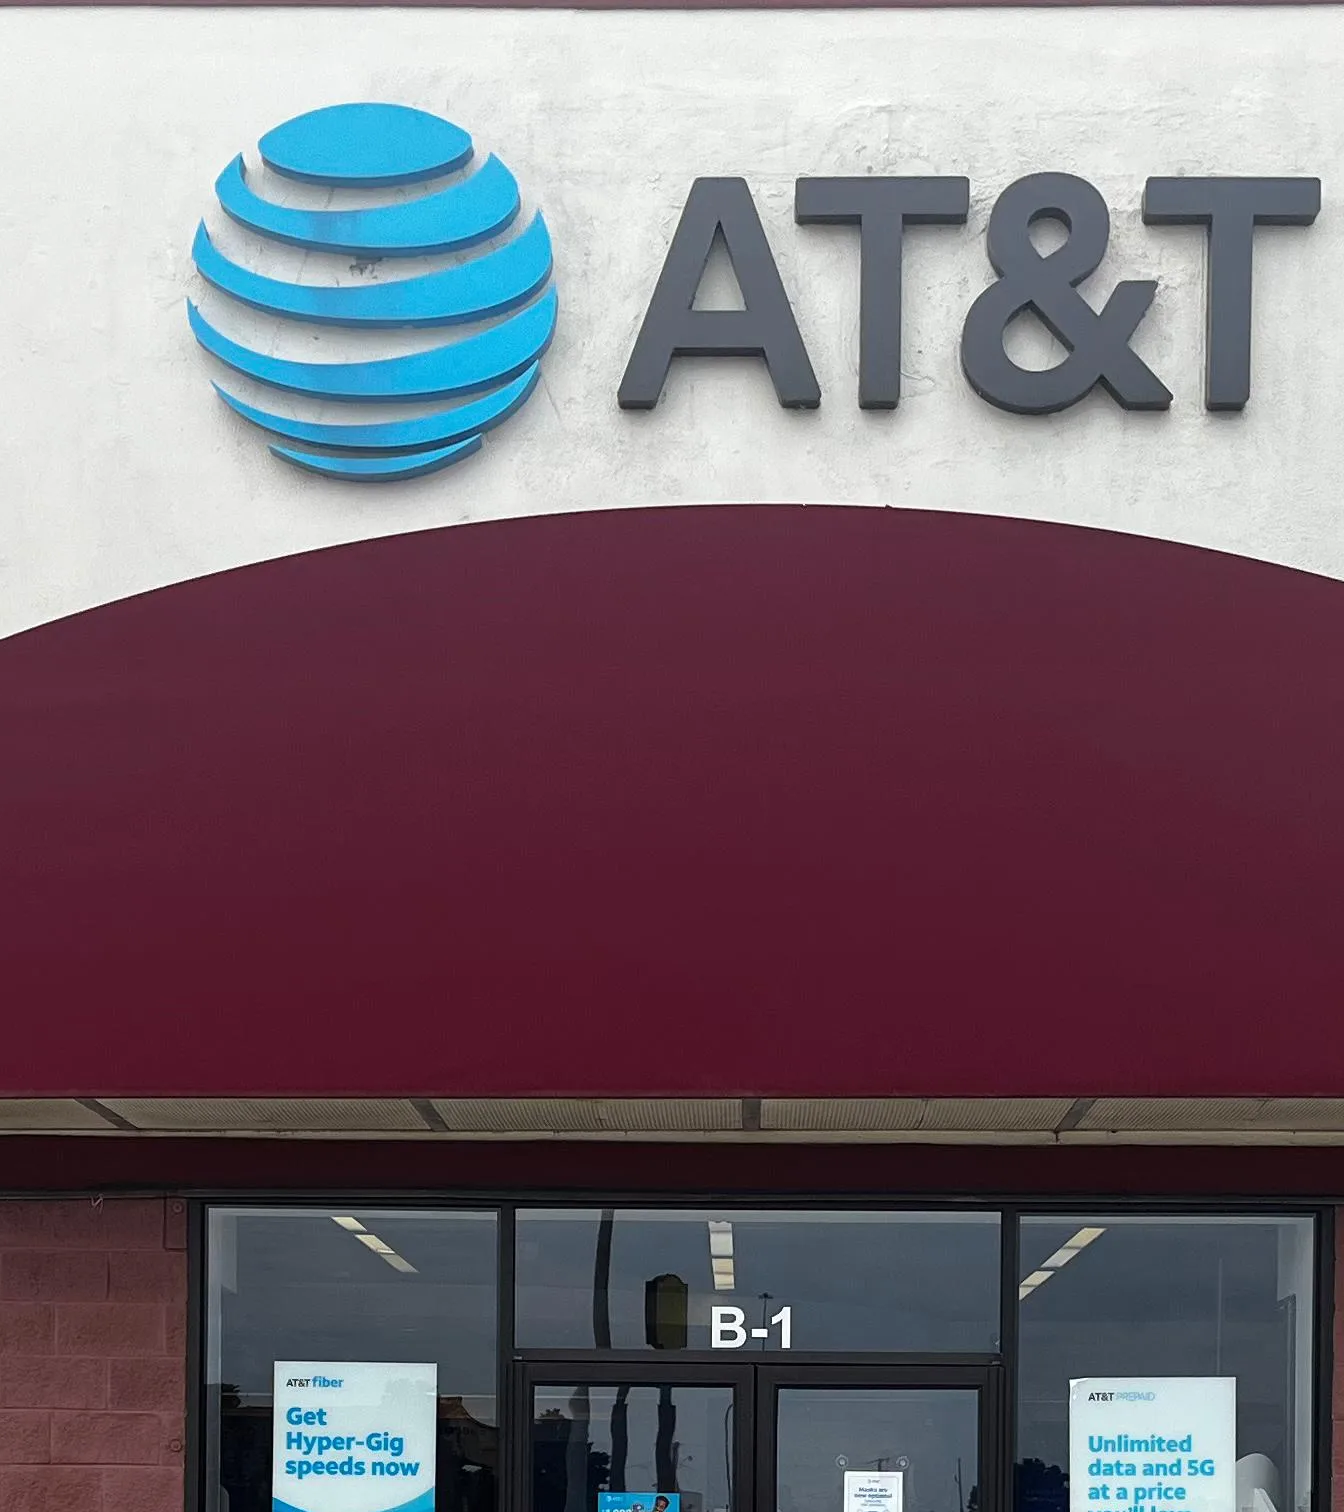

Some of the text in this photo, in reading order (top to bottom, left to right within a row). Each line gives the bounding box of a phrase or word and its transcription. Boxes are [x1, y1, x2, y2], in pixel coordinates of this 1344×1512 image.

[616, 172, 1321, 415] AT&T
[712, 1306, 791, 1349] B-1
[286, 1375, 344, 1388] AT&T fiber
[1088, 1391, 1155, 1401] AT&T PREPAID
[286, 1407, 327, 1426] Get
[286, 1432, 404, 1456] Hyper-Gig
[1088, 1434, 1192, 1452] Unlimited
[285, 1456, 420, 1479] speeds now
[1088, 1458, 1215, 1476] data and 5G
[1088, 1482, 1186, 1504] at a price
